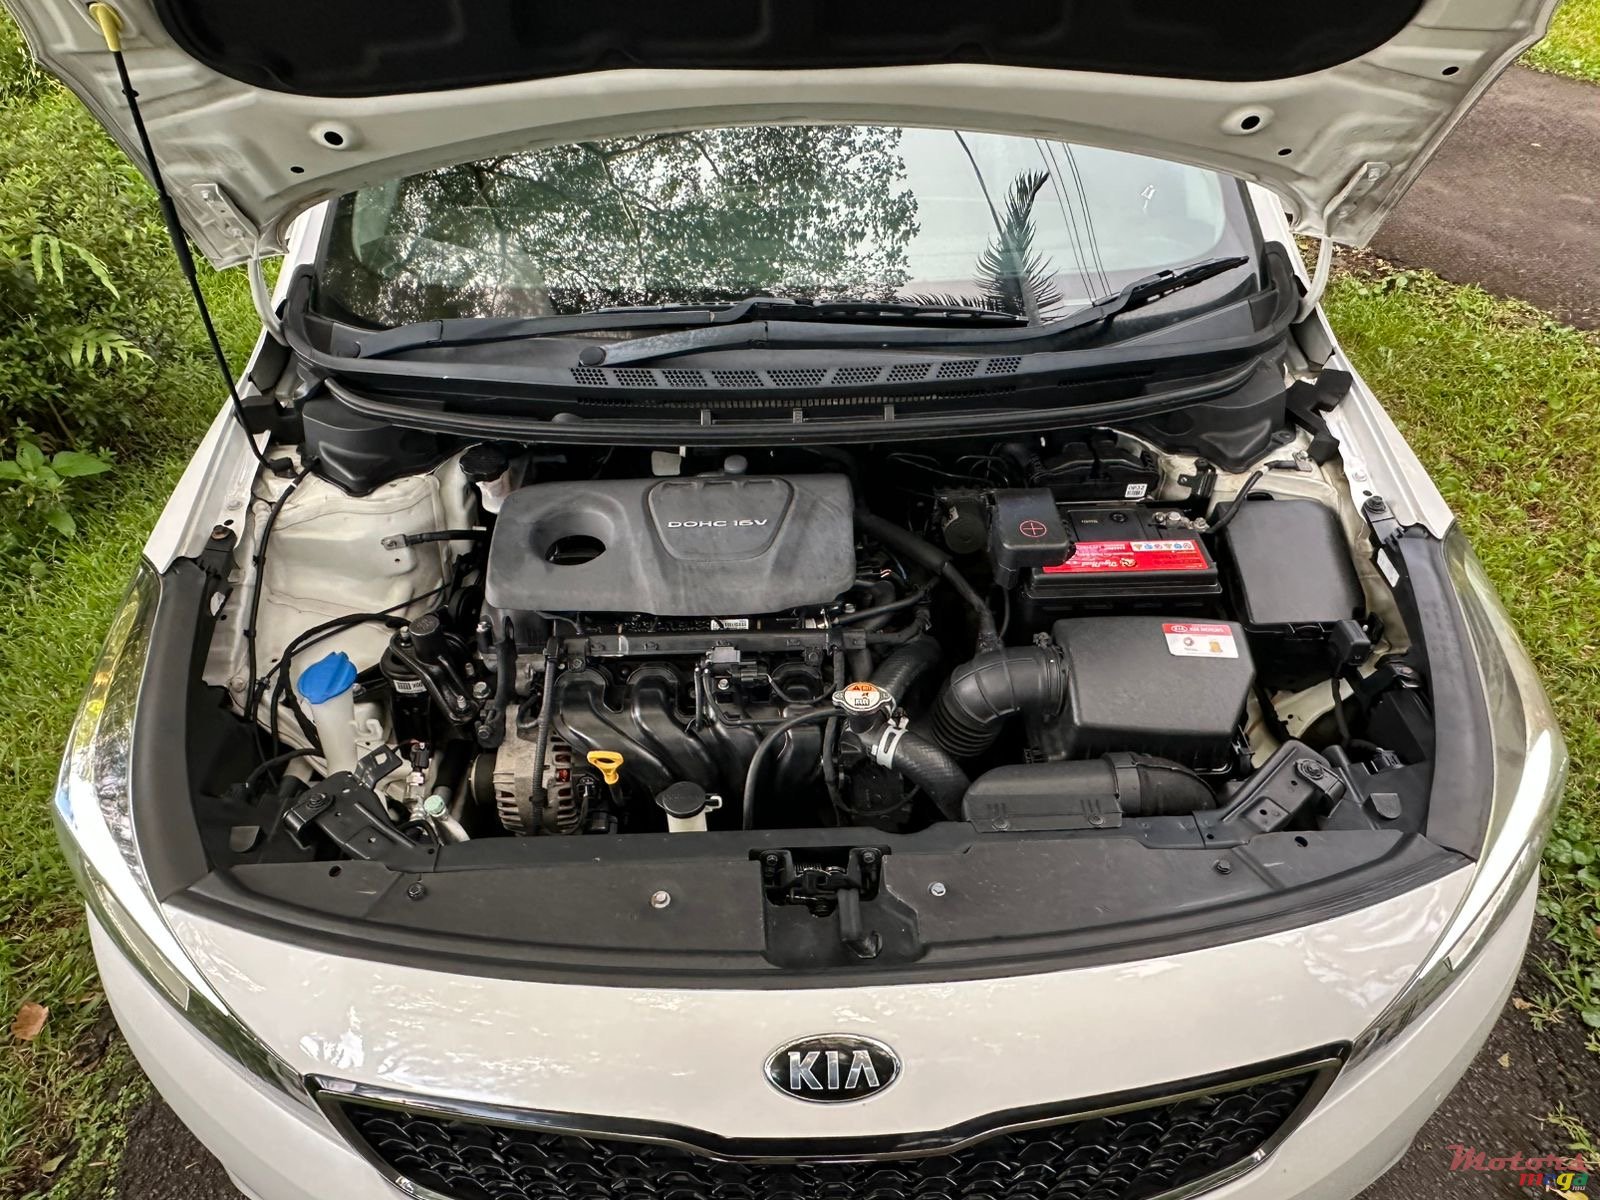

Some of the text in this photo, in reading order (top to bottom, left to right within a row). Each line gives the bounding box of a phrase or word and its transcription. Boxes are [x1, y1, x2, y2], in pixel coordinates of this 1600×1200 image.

[667, 519, 768, 528] DOHC 16V
[787, 1050, 880, 1090] KIA
